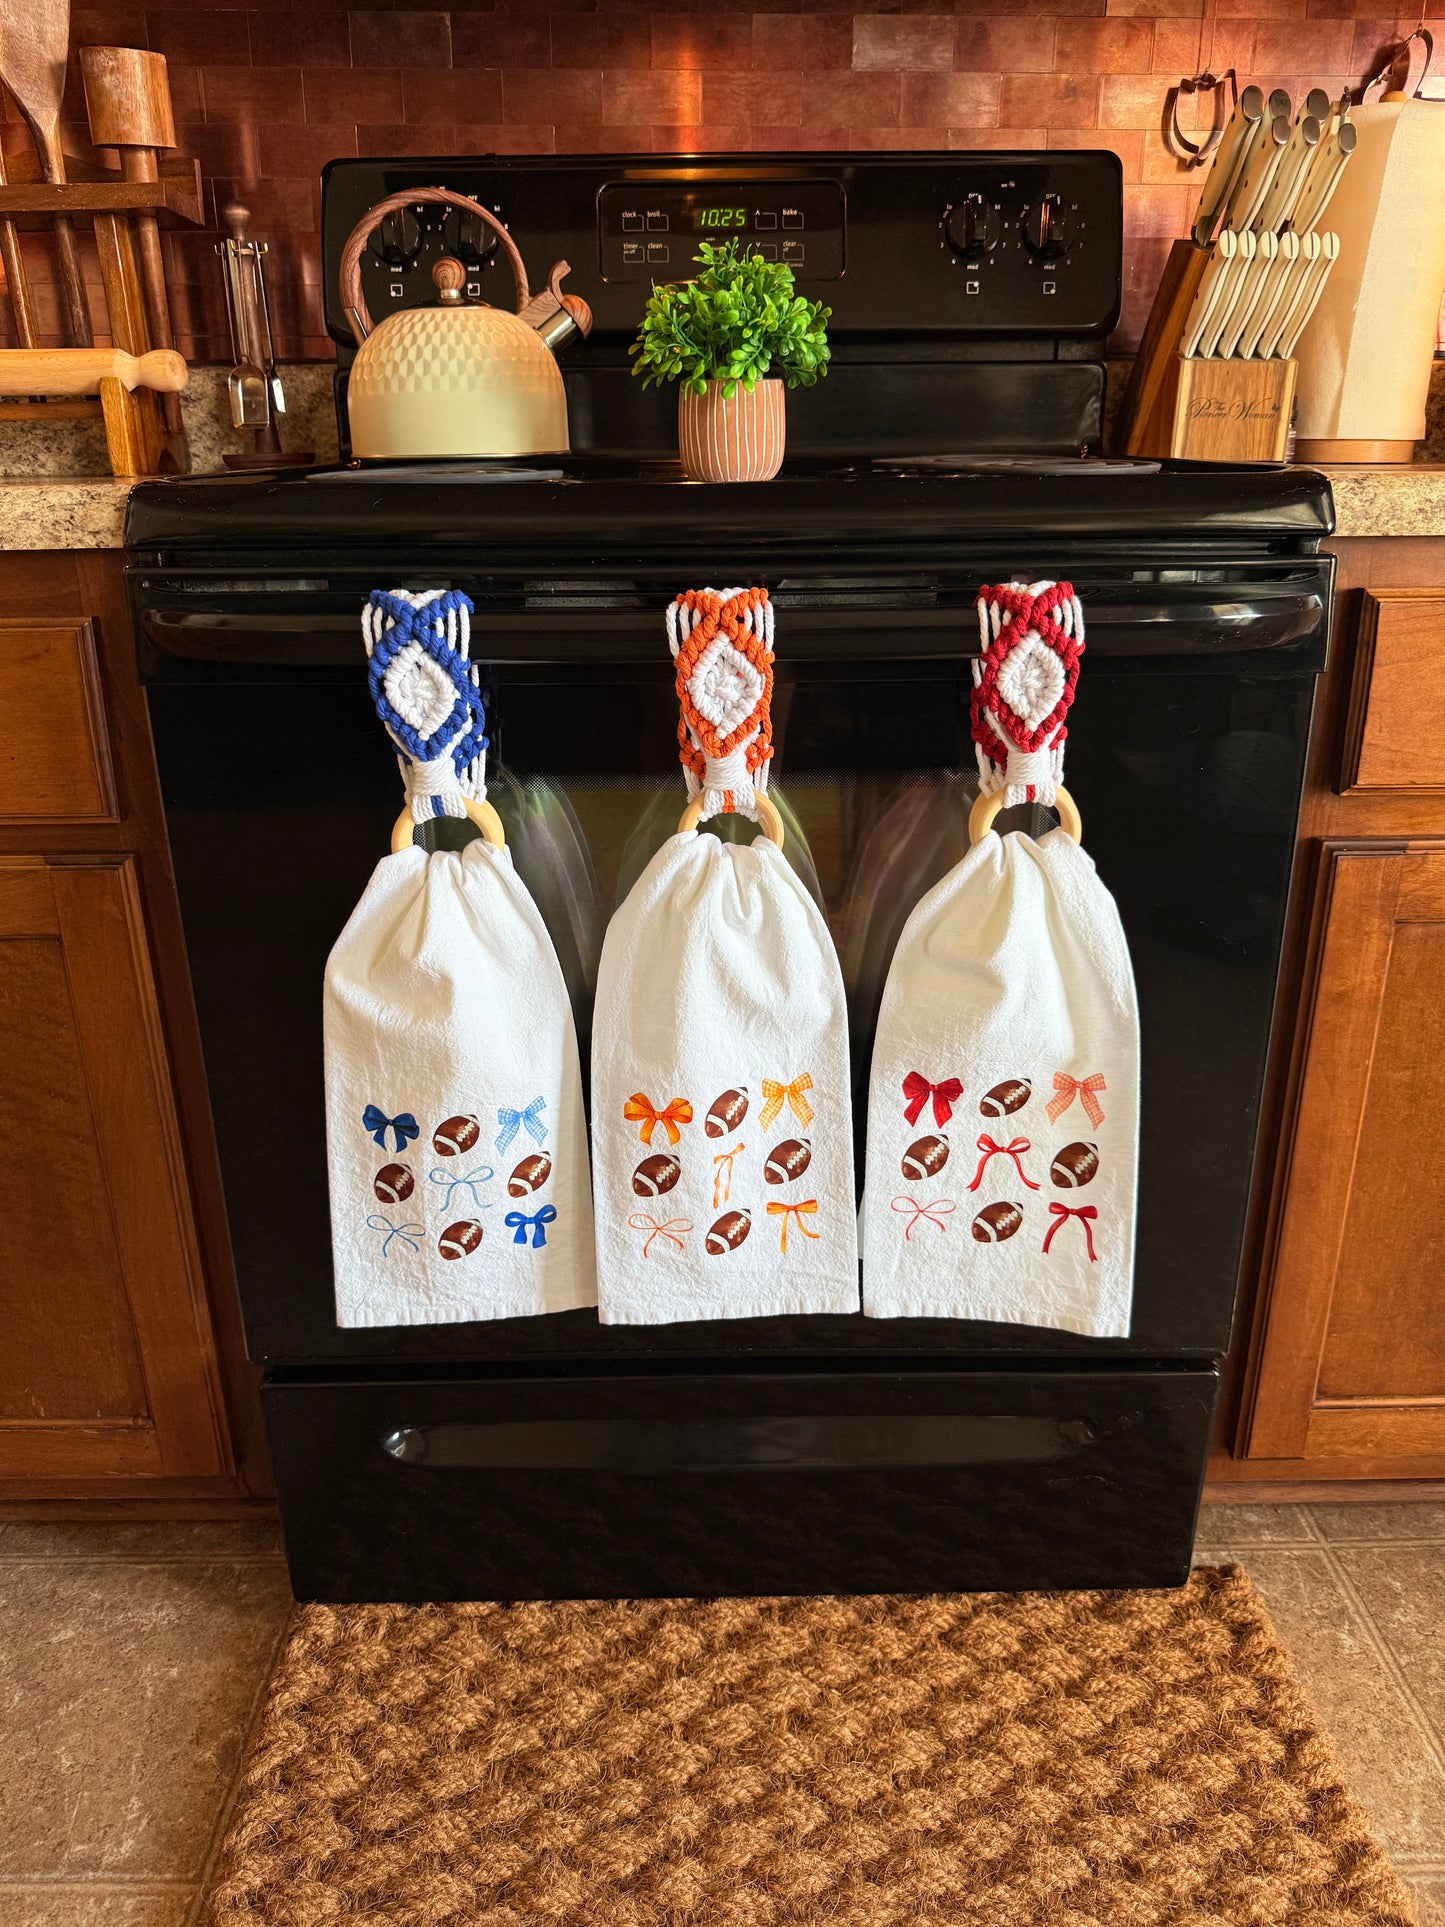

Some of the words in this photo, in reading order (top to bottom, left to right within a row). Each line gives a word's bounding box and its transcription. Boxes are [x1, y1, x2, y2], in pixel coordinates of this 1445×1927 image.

[646, 210, 661, 218] broil
[782, 208, 798, 216] bake
[623, 242, 639, 250] timer
[647, 242, 663, 250] clean
[390, 265, 403, 273] med
[466, 264, 480, 272] med
[1185, 397, 1228, 419] Pioneer
[1228, 397, 1276, 421] Woman
